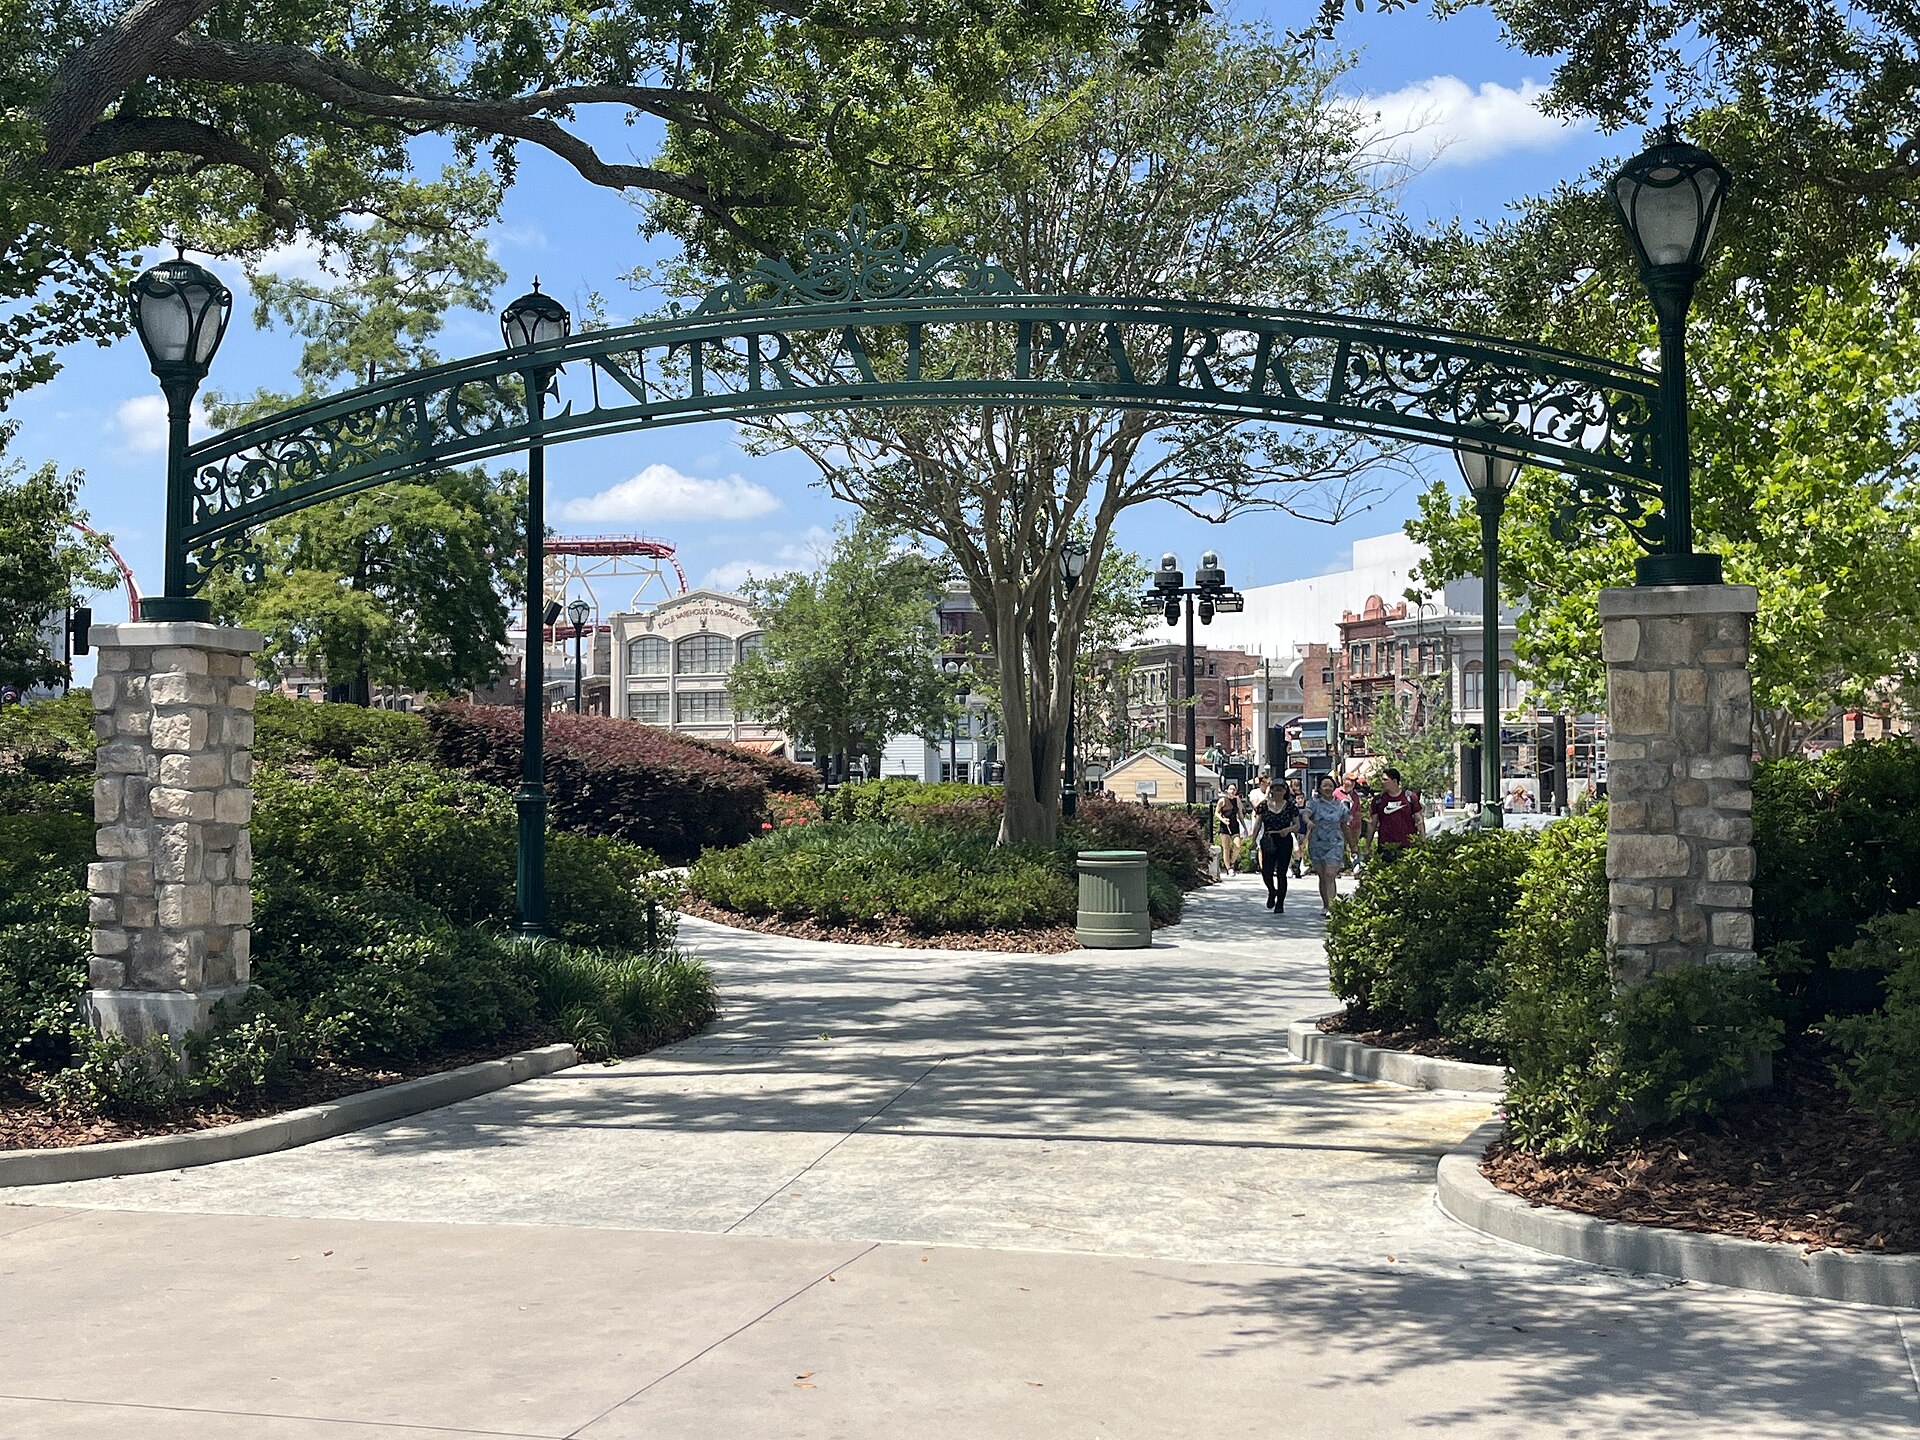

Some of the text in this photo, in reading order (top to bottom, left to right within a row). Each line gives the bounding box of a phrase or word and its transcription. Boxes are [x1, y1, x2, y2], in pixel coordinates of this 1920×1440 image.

[447, 319, 1304, 438] CENTRAL PARK
[657, 615, 676, 629] EAGLE
[675, 608, 710, 621] WAREHOUSE
[714, 609, 741, 622] STORAGE
